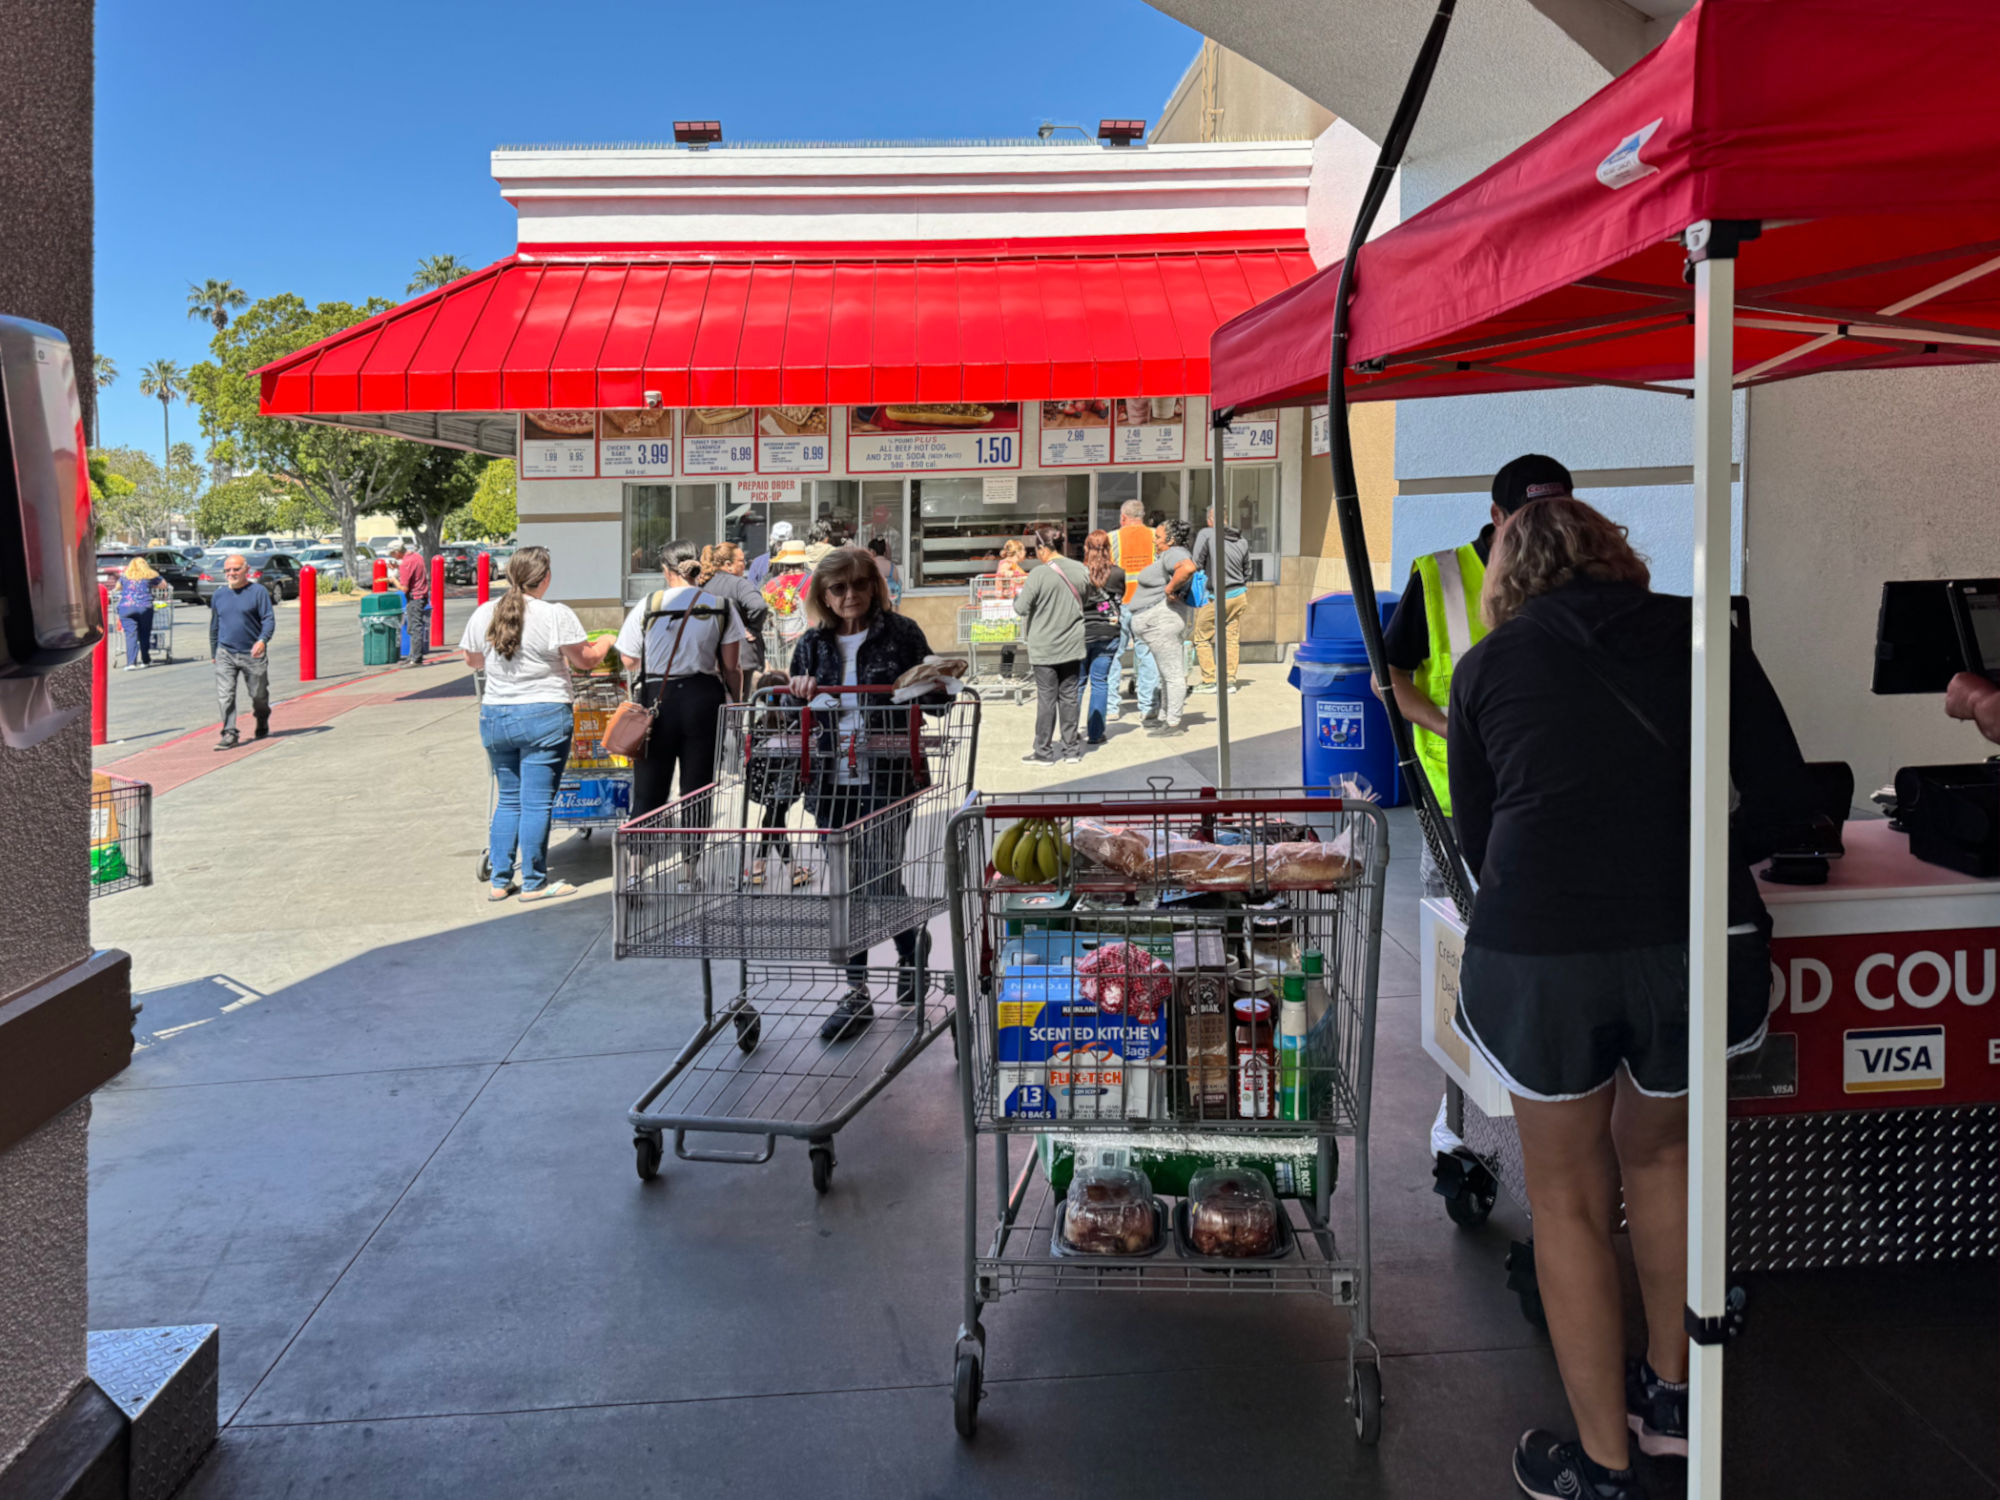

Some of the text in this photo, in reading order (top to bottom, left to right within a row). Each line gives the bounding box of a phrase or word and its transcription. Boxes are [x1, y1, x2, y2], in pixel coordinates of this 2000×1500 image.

[1249, 429, 1273, 446] 2.49
[637, 443, 669, 465] 3.99
[730, 446, 752, 461] 6.99
[803, 446, 824, 460] 6.99
[931, 443, 946, 451] DOG
[975, 436, 1012, 464] 1.50
[866, 453, 882, 461] AND
[906, 452, 926, 460] SODA
[737, 480, 796, 491] PREPAID ORDER
[751, 491, 782, 502] PICK-UP
[1324, 704, 1354, 713] RECYCLE
[565, 793, 601, 808] Tissue
[1854, 948, 1997, 1011] COU
[1190, 1003, 1220, 1014] KDIAK
[1029, 1026, 1160, 1041] SCENTED KITCHEN
[1125, 1048, 1151, 1059] Bags
[1854, 1045, 1932, 1073] VISA
[1020, 1087, 1042, 1103] 13
[1772, 1085, 1794, 1094] VISA
[1028, 1110, 1052, 1119] BAGS
[1300, 1169, 1312, 1197] ROLLS
